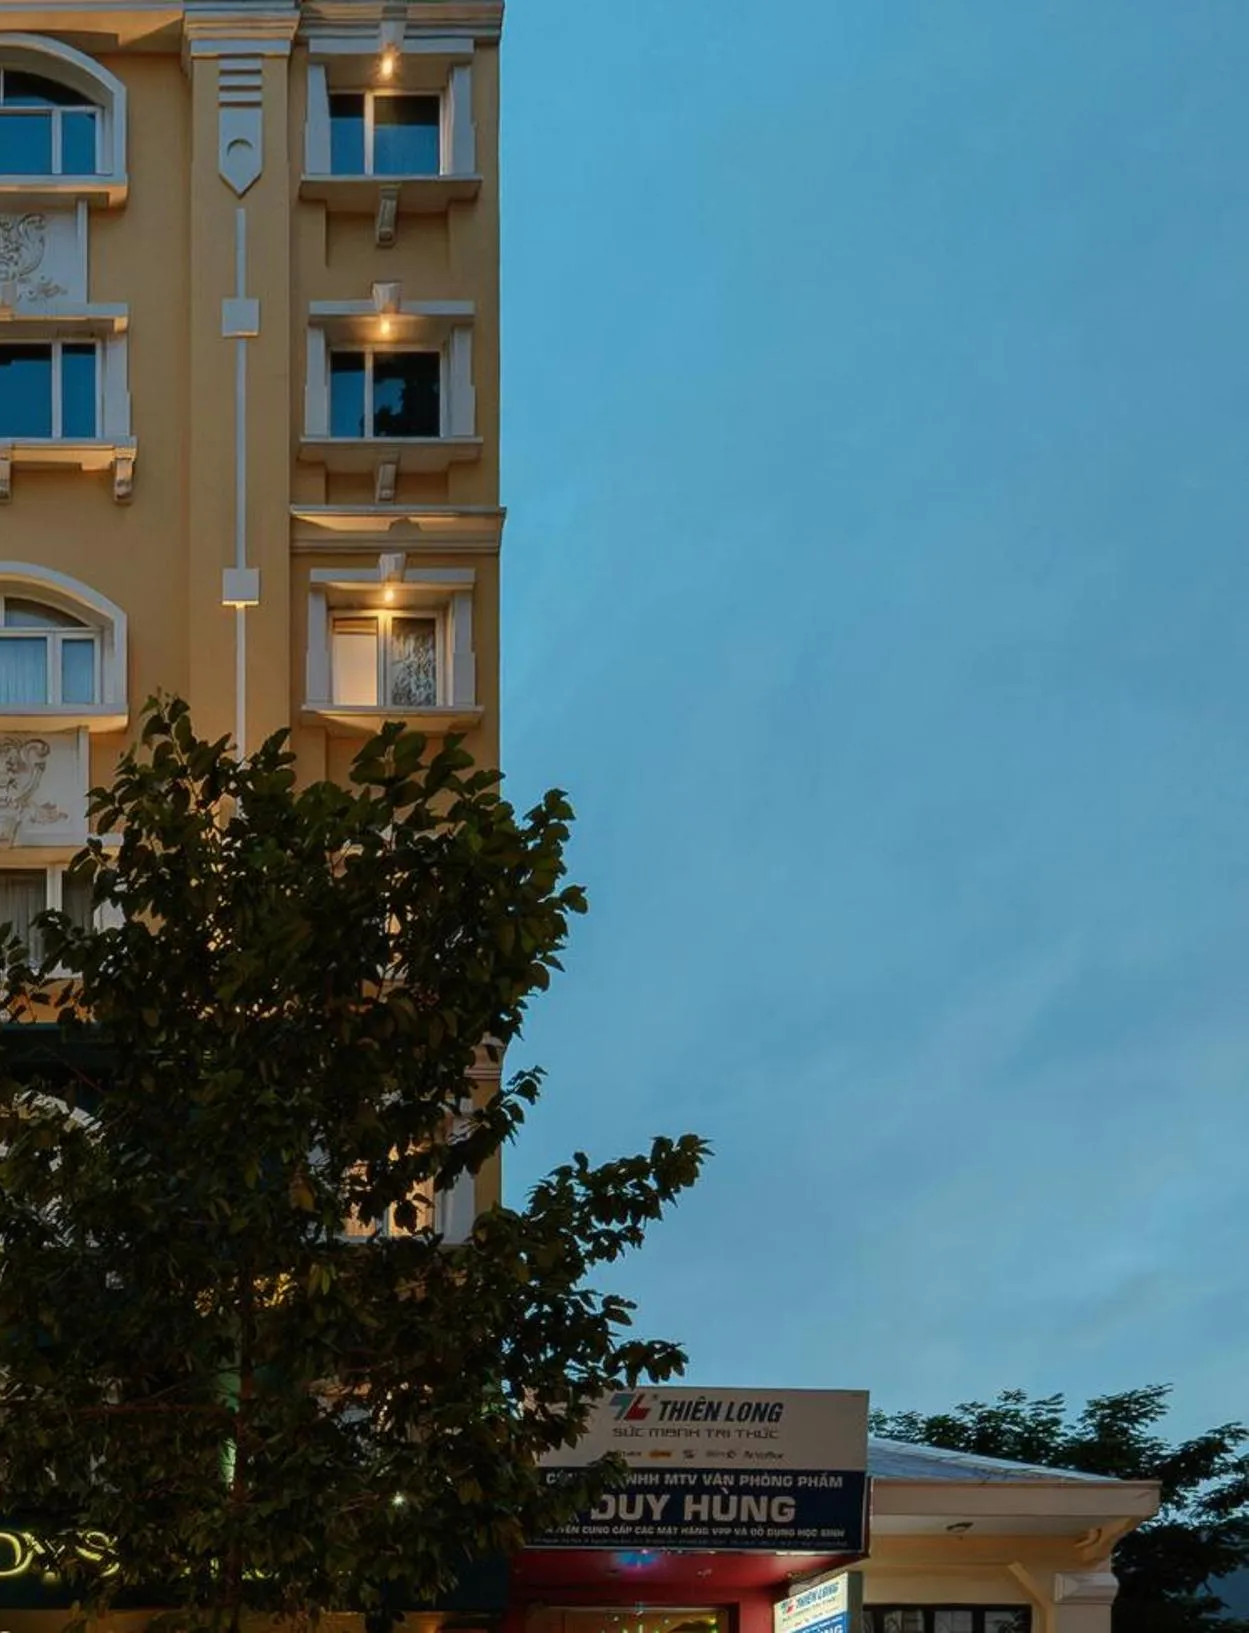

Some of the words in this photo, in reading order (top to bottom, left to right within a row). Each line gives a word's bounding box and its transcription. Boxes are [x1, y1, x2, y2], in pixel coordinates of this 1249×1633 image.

[658, 1395, 723, 1423] THIÊN
[725, 1401, 784, 1424] LONG
[664, 1474, 698, 1486] MTV
[590, 1494, 671, 1521] DUY
[683, 1487, 797, 1523] HÙNG
